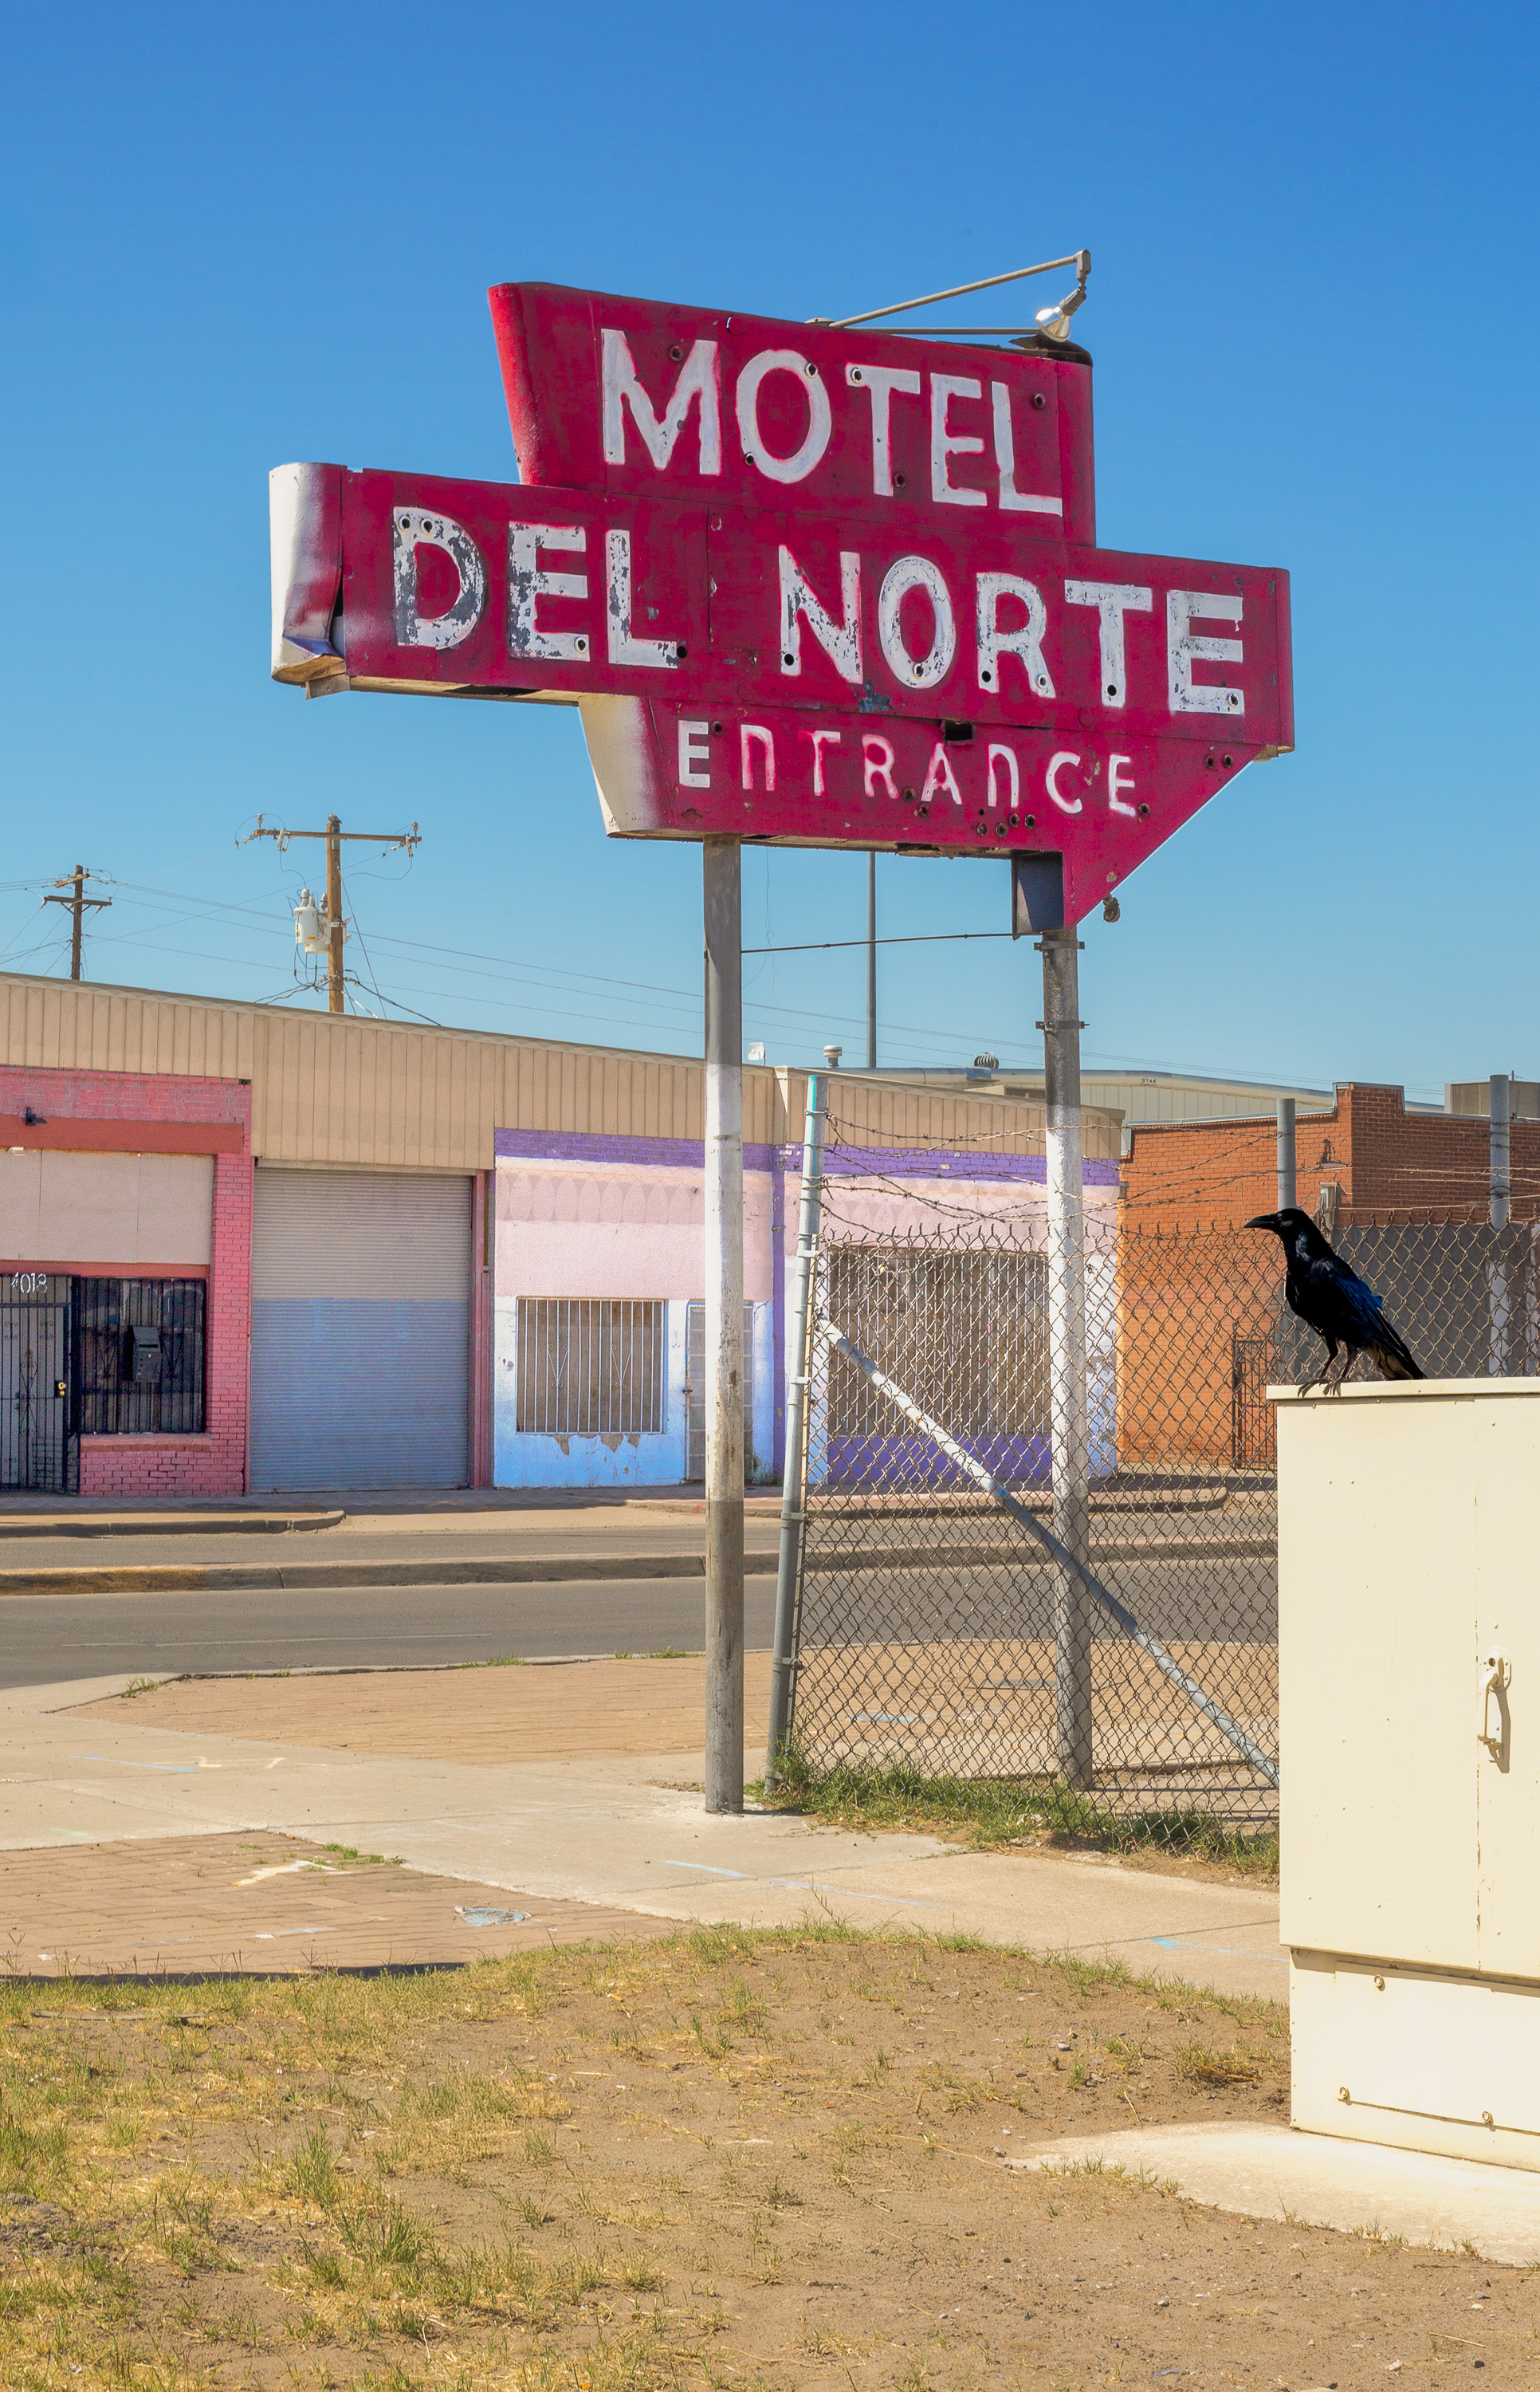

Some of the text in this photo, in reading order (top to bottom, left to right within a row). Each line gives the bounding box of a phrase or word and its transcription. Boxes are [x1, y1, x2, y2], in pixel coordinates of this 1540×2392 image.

[599, 328, 1063, 517] MOTEL
[393, 506, 1244, 715] DEL NORTE
[678, 720, 1136, 817] ENTRANCE
[10, 1271, 48, 1294] 4018
